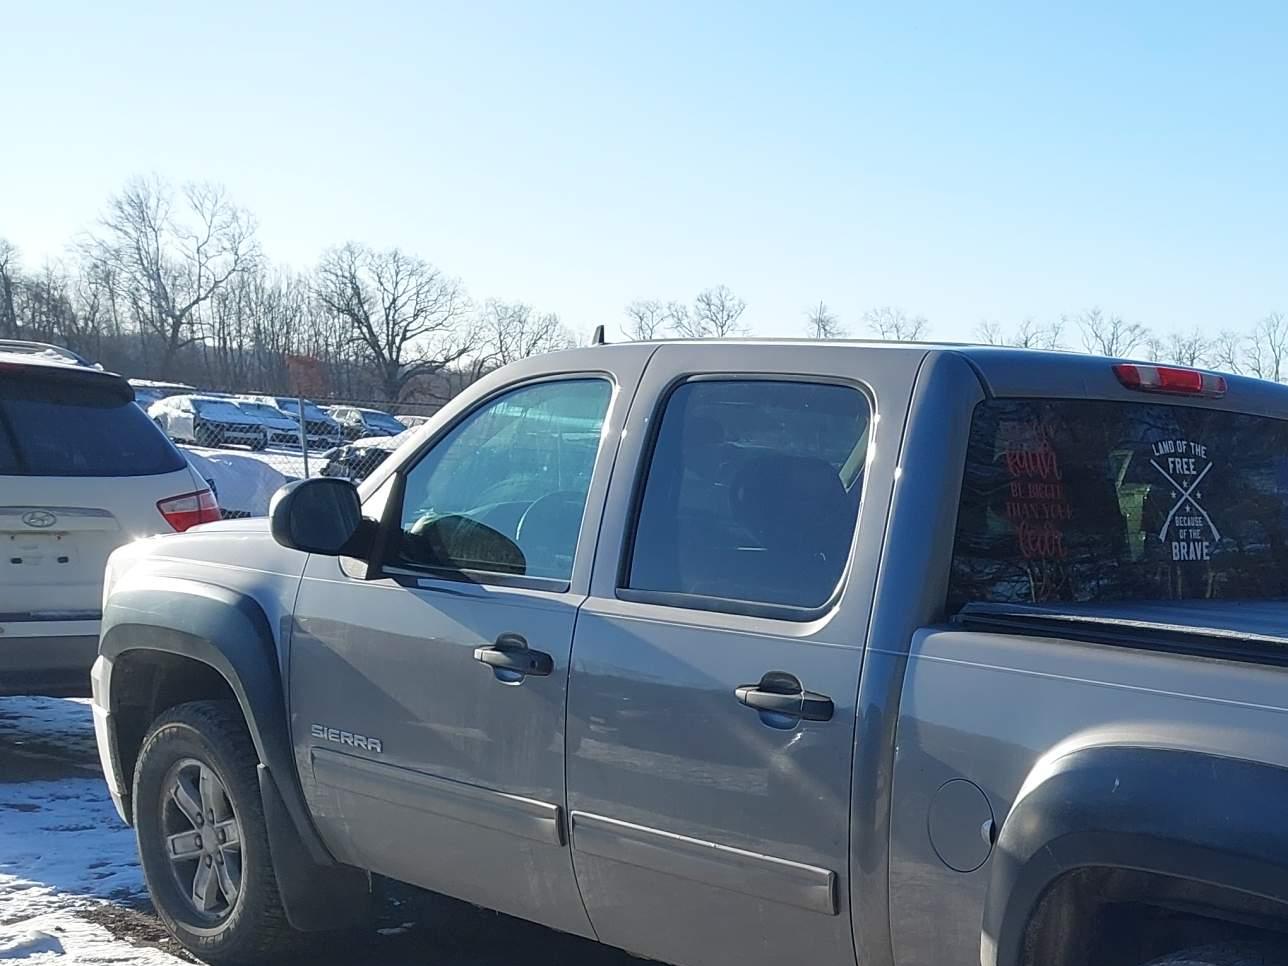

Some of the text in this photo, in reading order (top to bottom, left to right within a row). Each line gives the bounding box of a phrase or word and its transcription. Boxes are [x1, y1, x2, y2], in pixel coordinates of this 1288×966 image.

[1152, 440, 1207, 459] LAND OF THE
[1168, 457, 1197, 475] FREE
[1175, 516, 1203, 527] BECAUSE
[1179, 529, 1201, 539] OF THE
[1172, 541, 1210, 560] BRAVE
[311, 724, 383, 753] SIERRA
